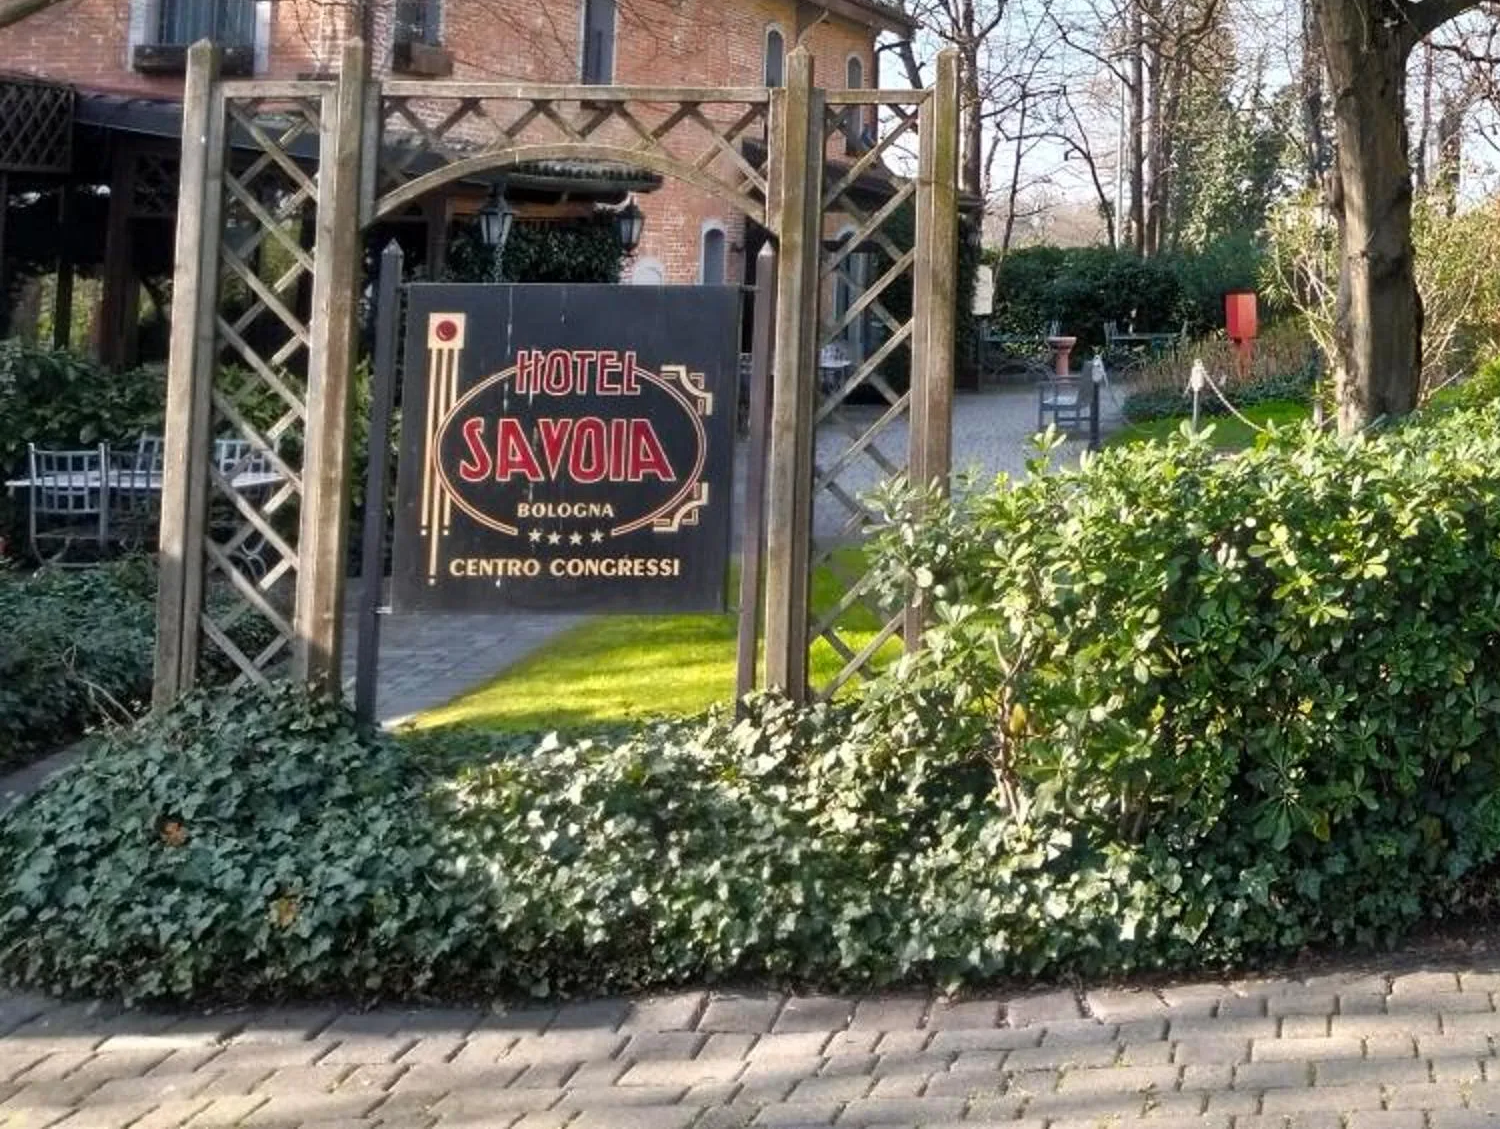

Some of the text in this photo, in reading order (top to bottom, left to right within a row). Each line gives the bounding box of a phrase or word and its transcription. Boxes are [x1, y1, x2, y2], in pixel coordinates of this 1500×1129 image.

[515, 349, 641, 396] HOTEL
[459, 416, 677, 484] SAVOIA
[517, 503, 615, 518] BOLOGNA
[449, 557, 680, 577] CENTRO CONGRESSI
